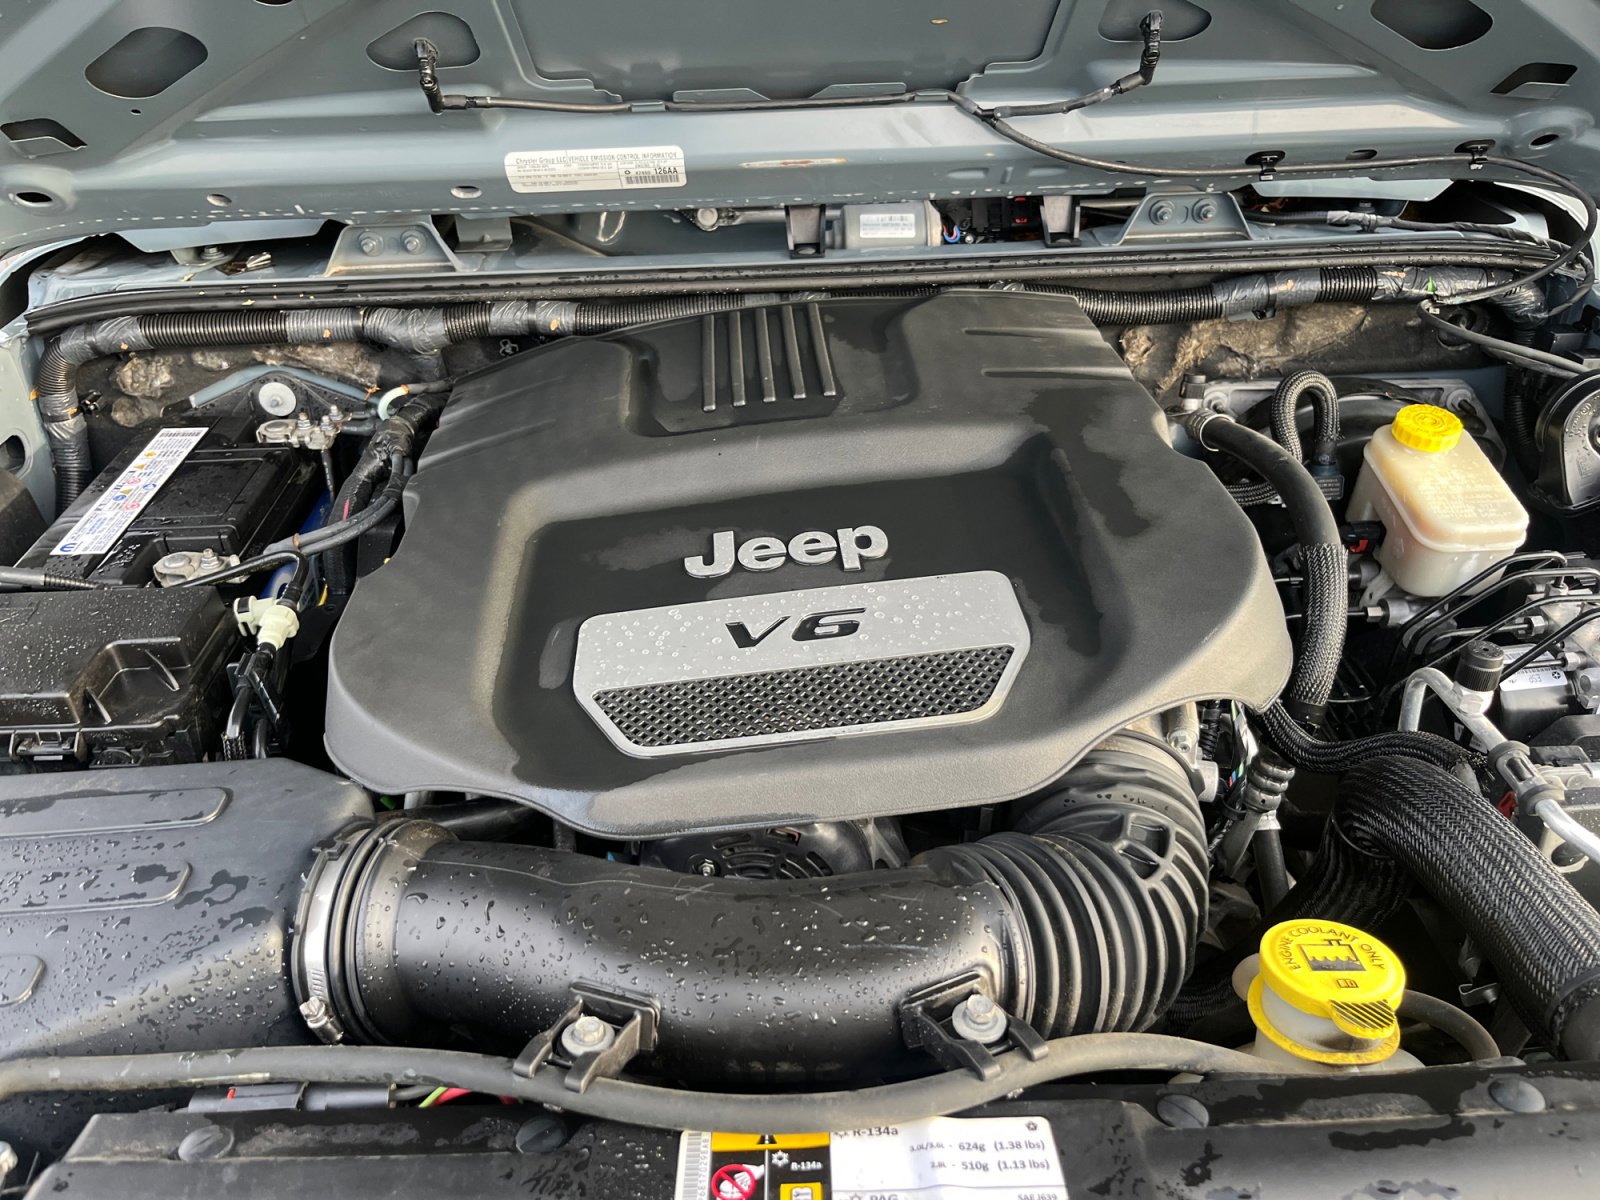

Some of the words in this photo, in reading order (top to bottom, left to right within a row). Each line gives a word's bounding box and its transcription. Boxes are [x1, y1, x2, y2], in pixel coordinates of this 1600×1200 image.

[515, 157, 538, 166] Chrysler
[538, 156, 555, 165] Group
[556, 155, 567, 163] LLC
[568, 154, 589, 163] VEHICLE
[590, 153, 615, 162] EMISSION
[616, 153, 639, 161] CONTROL
[641, 151, 677, 160] INFORMATION
[654, 167, 678, 175] 126AA
[683, 524, 889, 579] Jeep
[725, 607, 867, 649] V6
[1289, 927, 1358, 943] COOLANT
[1279, 935, 1301, 971] ENGINE
[1361, 943, 1386, 970] ONLY
[852, 1126, 899, 1137] R-134a
[958, 1142, 986, 1152] 624g
[993, 1140, 1022, 1152] (1.38
[1025, 1140, 1045, 1151] lbs)
[790, 1160, 822, 1171] R-134a
[961, 1160, 989, 1172] 510g
[997, 1159, 1026, 1172] (1.13
[1029, 1159, 1050, 1171] lbs)
